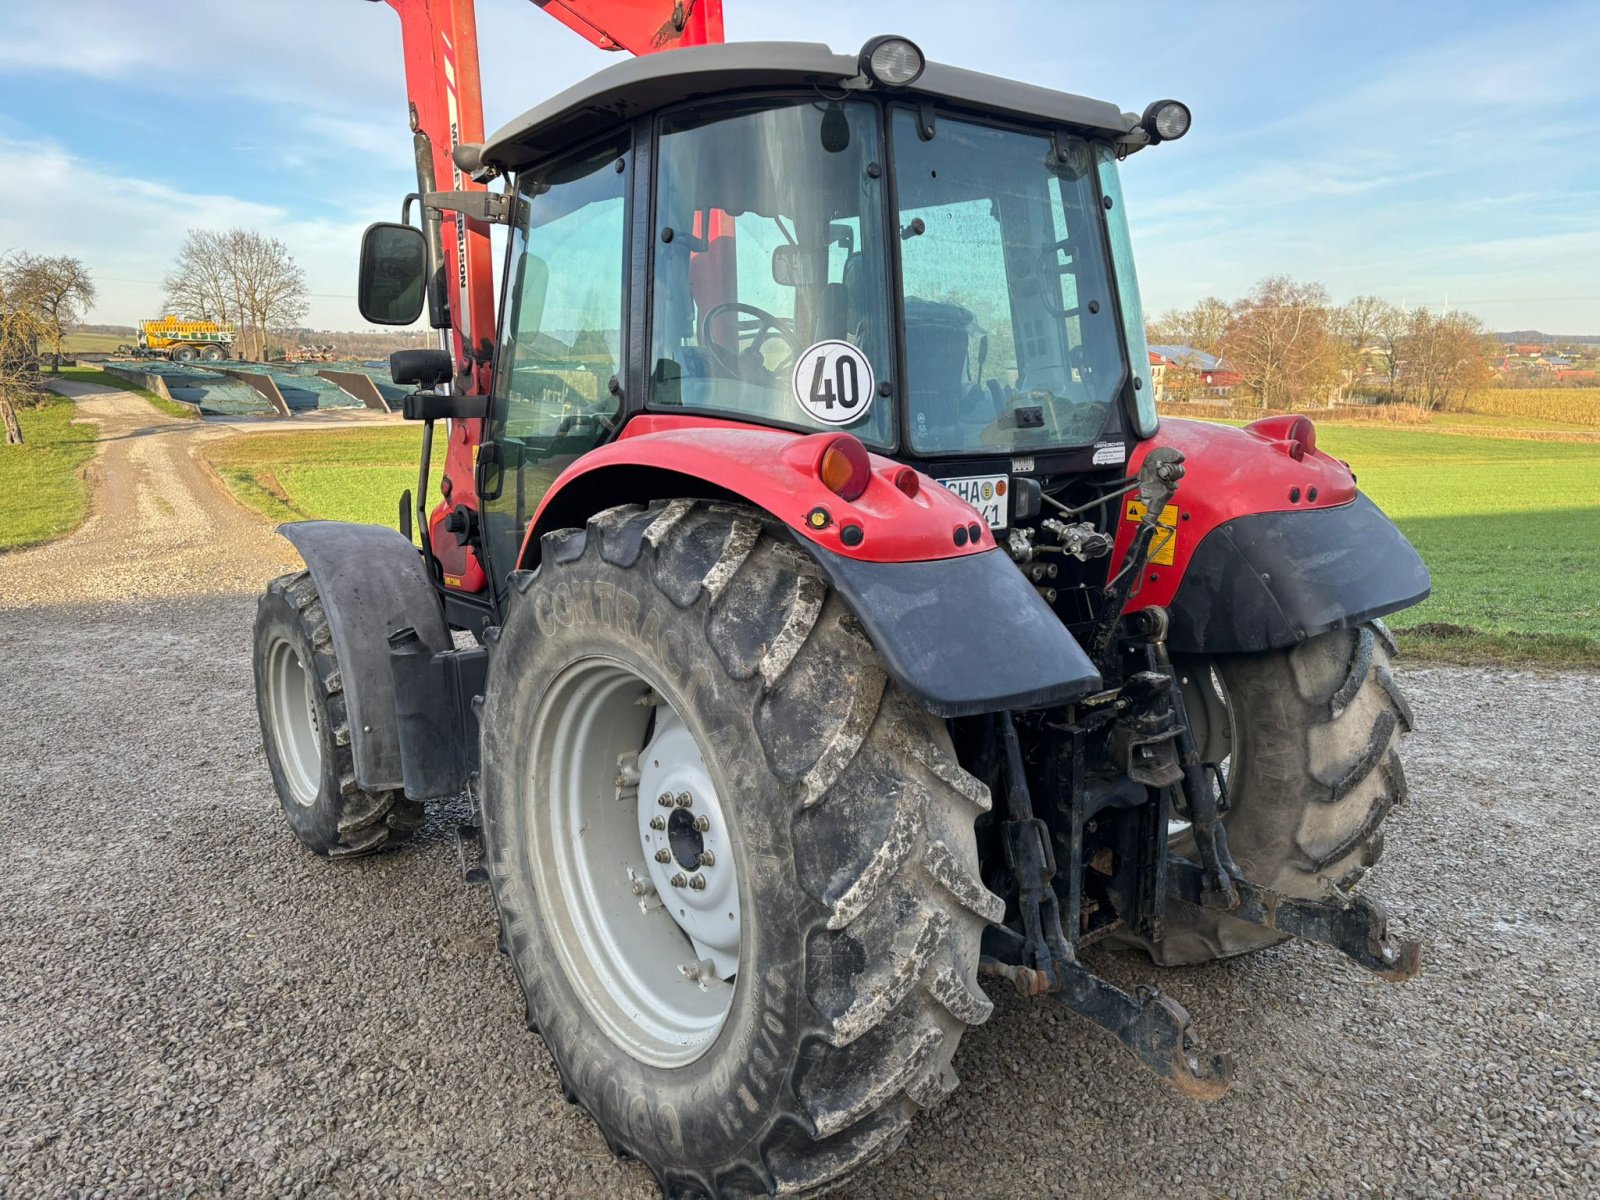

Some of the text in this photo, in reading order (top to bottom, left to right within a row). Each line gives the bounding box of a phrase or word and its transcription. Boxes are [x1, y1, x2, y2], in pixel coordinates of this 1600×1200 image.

[457, 211, 466, 288] ERGUSON
[810, 355, 859, 409] 40
[534, 580, 712, 703] CONTRACT
